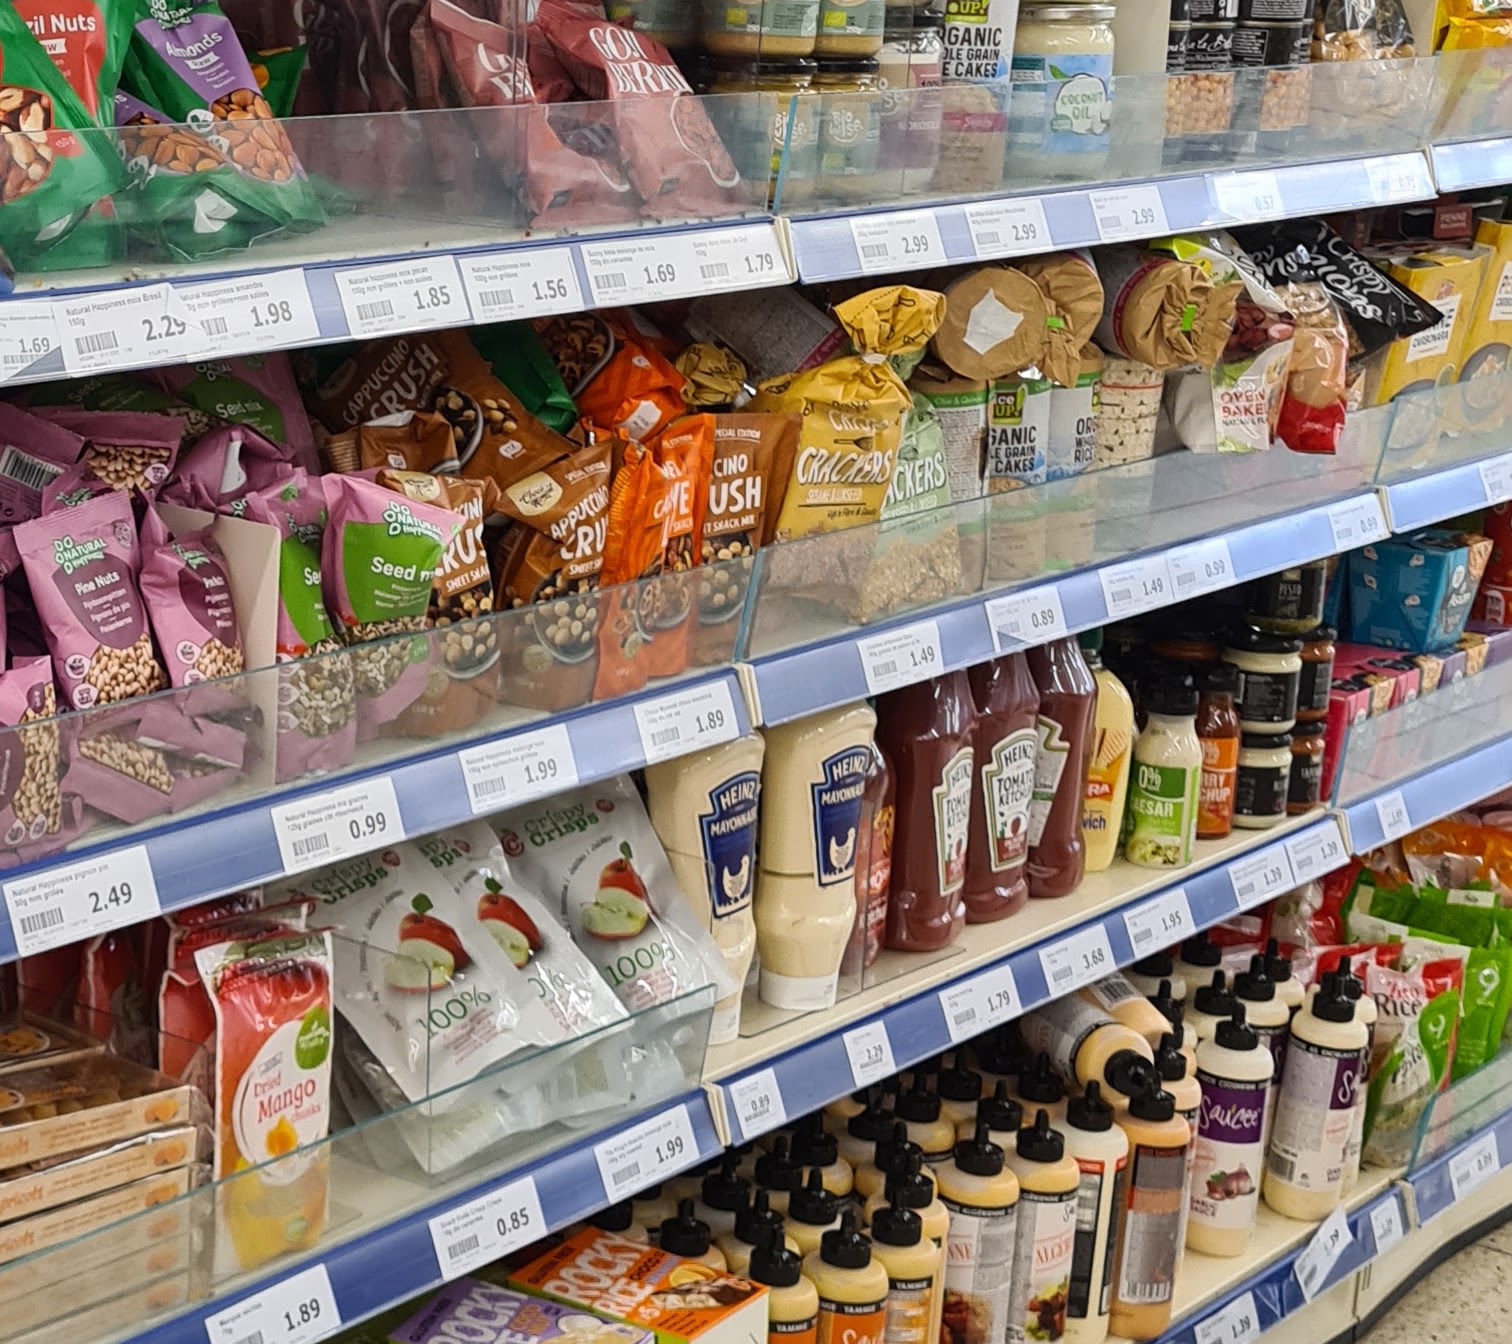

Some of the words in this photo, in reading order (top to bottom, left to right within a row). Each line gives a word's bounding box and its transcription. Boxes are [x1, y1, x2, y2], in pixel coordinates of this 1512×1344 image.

[49, 12, 96, 34] Nuts
[164, 30, 224, 58] Almonds
[966, 47, 1001, 62] GRAIN
[954, 61, 999, 79] CAKES
[1060, 91, 1104, 107] COCONUT
[1131, 207, 1156, 226] 2.99
[1011, 221, 1038, 241] 2.99
[900, 233, 930, 255] 2.99
[642, 262, 676, 285] 1.69
[743, 252, 774, 274] 1.79
[412, 285, 451, 311] 1.85
[531, 277, 567, 302] 1.56
[65, 304, 91, 317] Natural
[91, 297, 127, 314] Happiness
[249, 299, 293, 328] 1.98
[141, 314, 187, 342] 2.29
[18, 337, 50, 354] 1.69
[795, 446, 893, 486] CRACKERS
[994, 457, 1035, 475] CAKES
[370, 555, 417, 581] Seed
[1204, 559, 1225, 578] 0.99
[74, 574, 98, 597] Pine
[98, 569, 121, 591] Nuts
[1142, 578, 1164, 597] 1.49
[1031, 608, 1055, 629] 0.89
[910, 646, 936, 667] 1.49
[695, 708, 725, 734] 1.89
[523, 758, 558, 785] 1.99
[833, 756, 866, 779] HEINZ
[1138, 765, 1162, 789] 0%
[719, 784, 757, 810] HEINZ
[349, 811, 387, 840] 0.99
[87, 881, 133, 914] 2.49
[1161, 909, 1184, 931] 1.95
[605, 942, 677, 989] 100%
[987, 989, 1011, 1012] 1.79
[1374, 993, 1421, 1017] Rice
[255, 1079, 317, 1125] Mango
[654, 1136, 684, 1167] 1.99
[495, 1206, 530, 1238] 0.85
[283, 1298, 322, 1332] 1.89
[1228, 1313, 1251, 1340] 1.39
